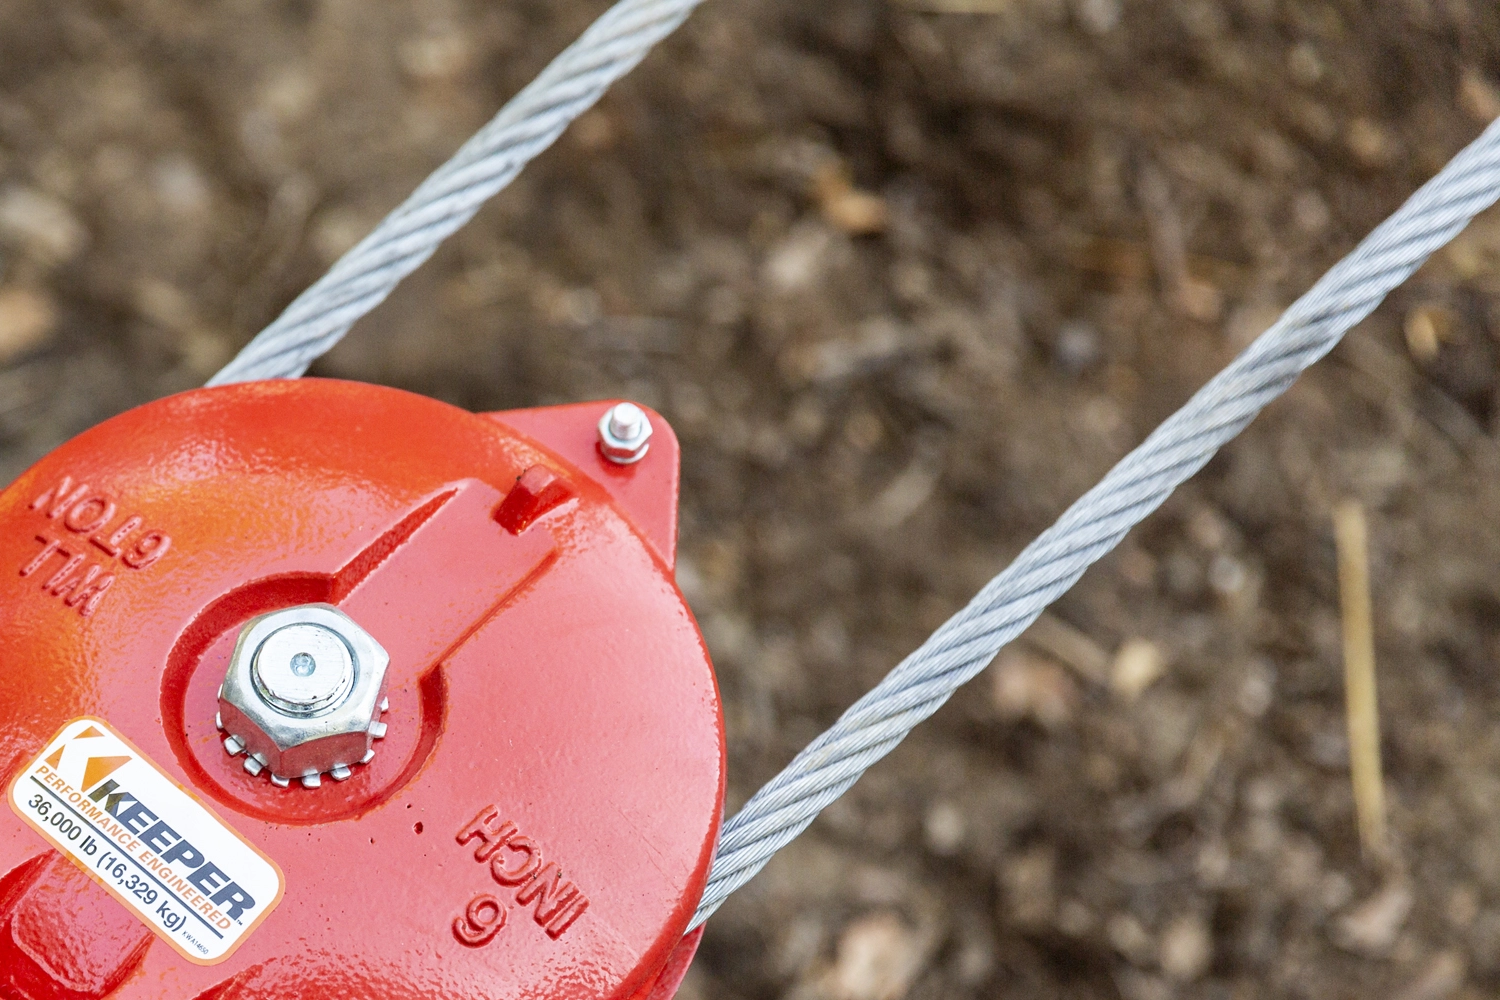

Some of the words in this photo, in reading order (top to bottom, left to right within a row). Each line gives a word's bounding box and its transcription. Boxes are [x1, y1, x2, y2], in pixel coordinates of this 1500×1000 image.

[28, 793, 82, 841] 36,000
[78, 834, 98, 856] lb
[96, 851, 159, 905] (16,329
[155, 900, 187, 932] kg)
[35, 765, 141, 852] PERFORMANCE
[138, 850, 231, 930] ENGINEERED
[455, 804, 590, 941] INCH
[452, 893, 507, 949] 6
